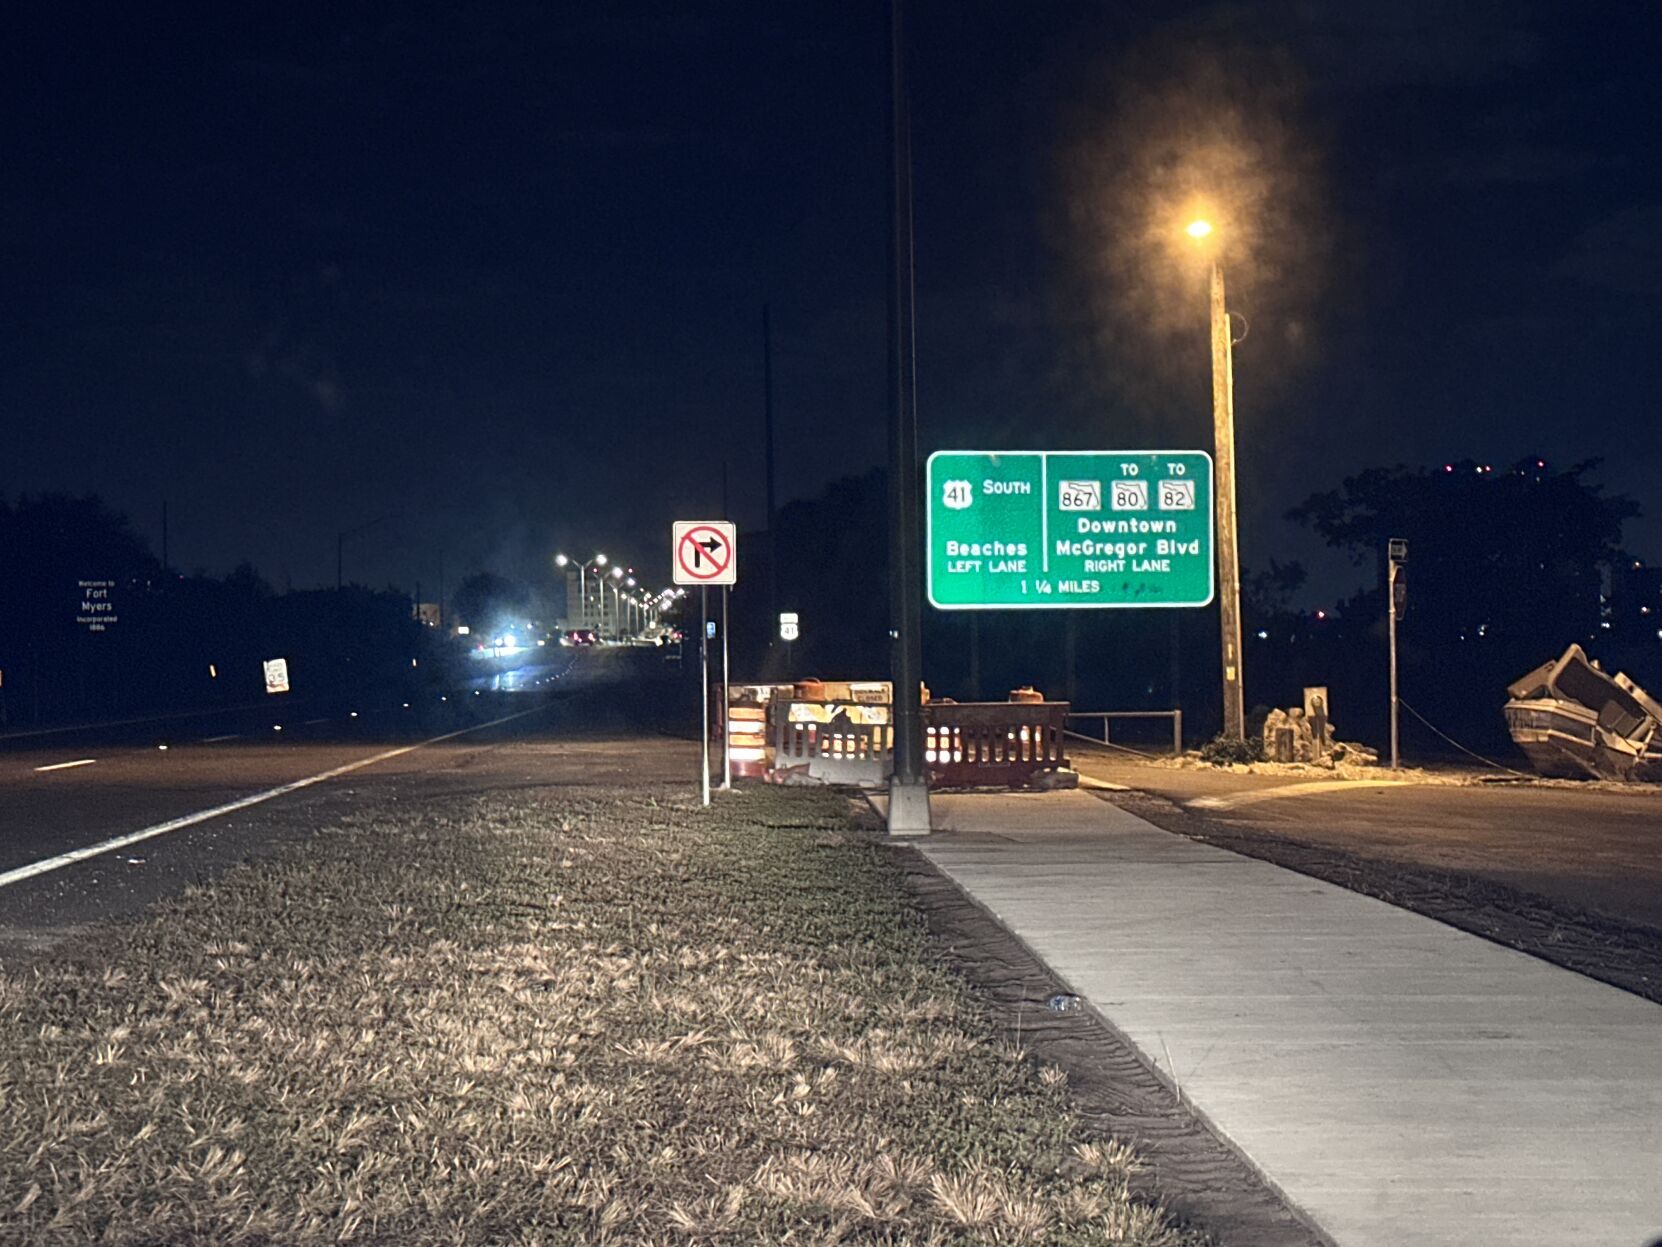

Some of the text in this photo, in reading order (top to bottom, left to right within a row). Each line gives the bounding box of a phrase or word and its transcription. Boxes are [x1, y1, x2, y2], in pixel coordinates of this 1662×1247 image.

[1120, 463, 1139, 476] TO
[1167, 463, 1185, 476] TO
[947, 486, 965, 503] 41
[1062, 492, 1093, 507] 867
[1117, 492, 1138, 506] 80
[1164, 492, 1185, 506] 82
[1077, 517, 1177, 533] Downtown
[946, 540, 1027, 556] Beaches
[1056, 538, 1199, 559] McGregor Blvd
[947, 560, 1028, 572] LEFT LANE
[1084, 559, 1171, 572] RIGHT LANE
[86, 588, 107, 599] Fort
[1021, 579, 1028, 595] 1
[1058, 580, 1100, 594] MILES
[81, 601, 112, 613] Myers
